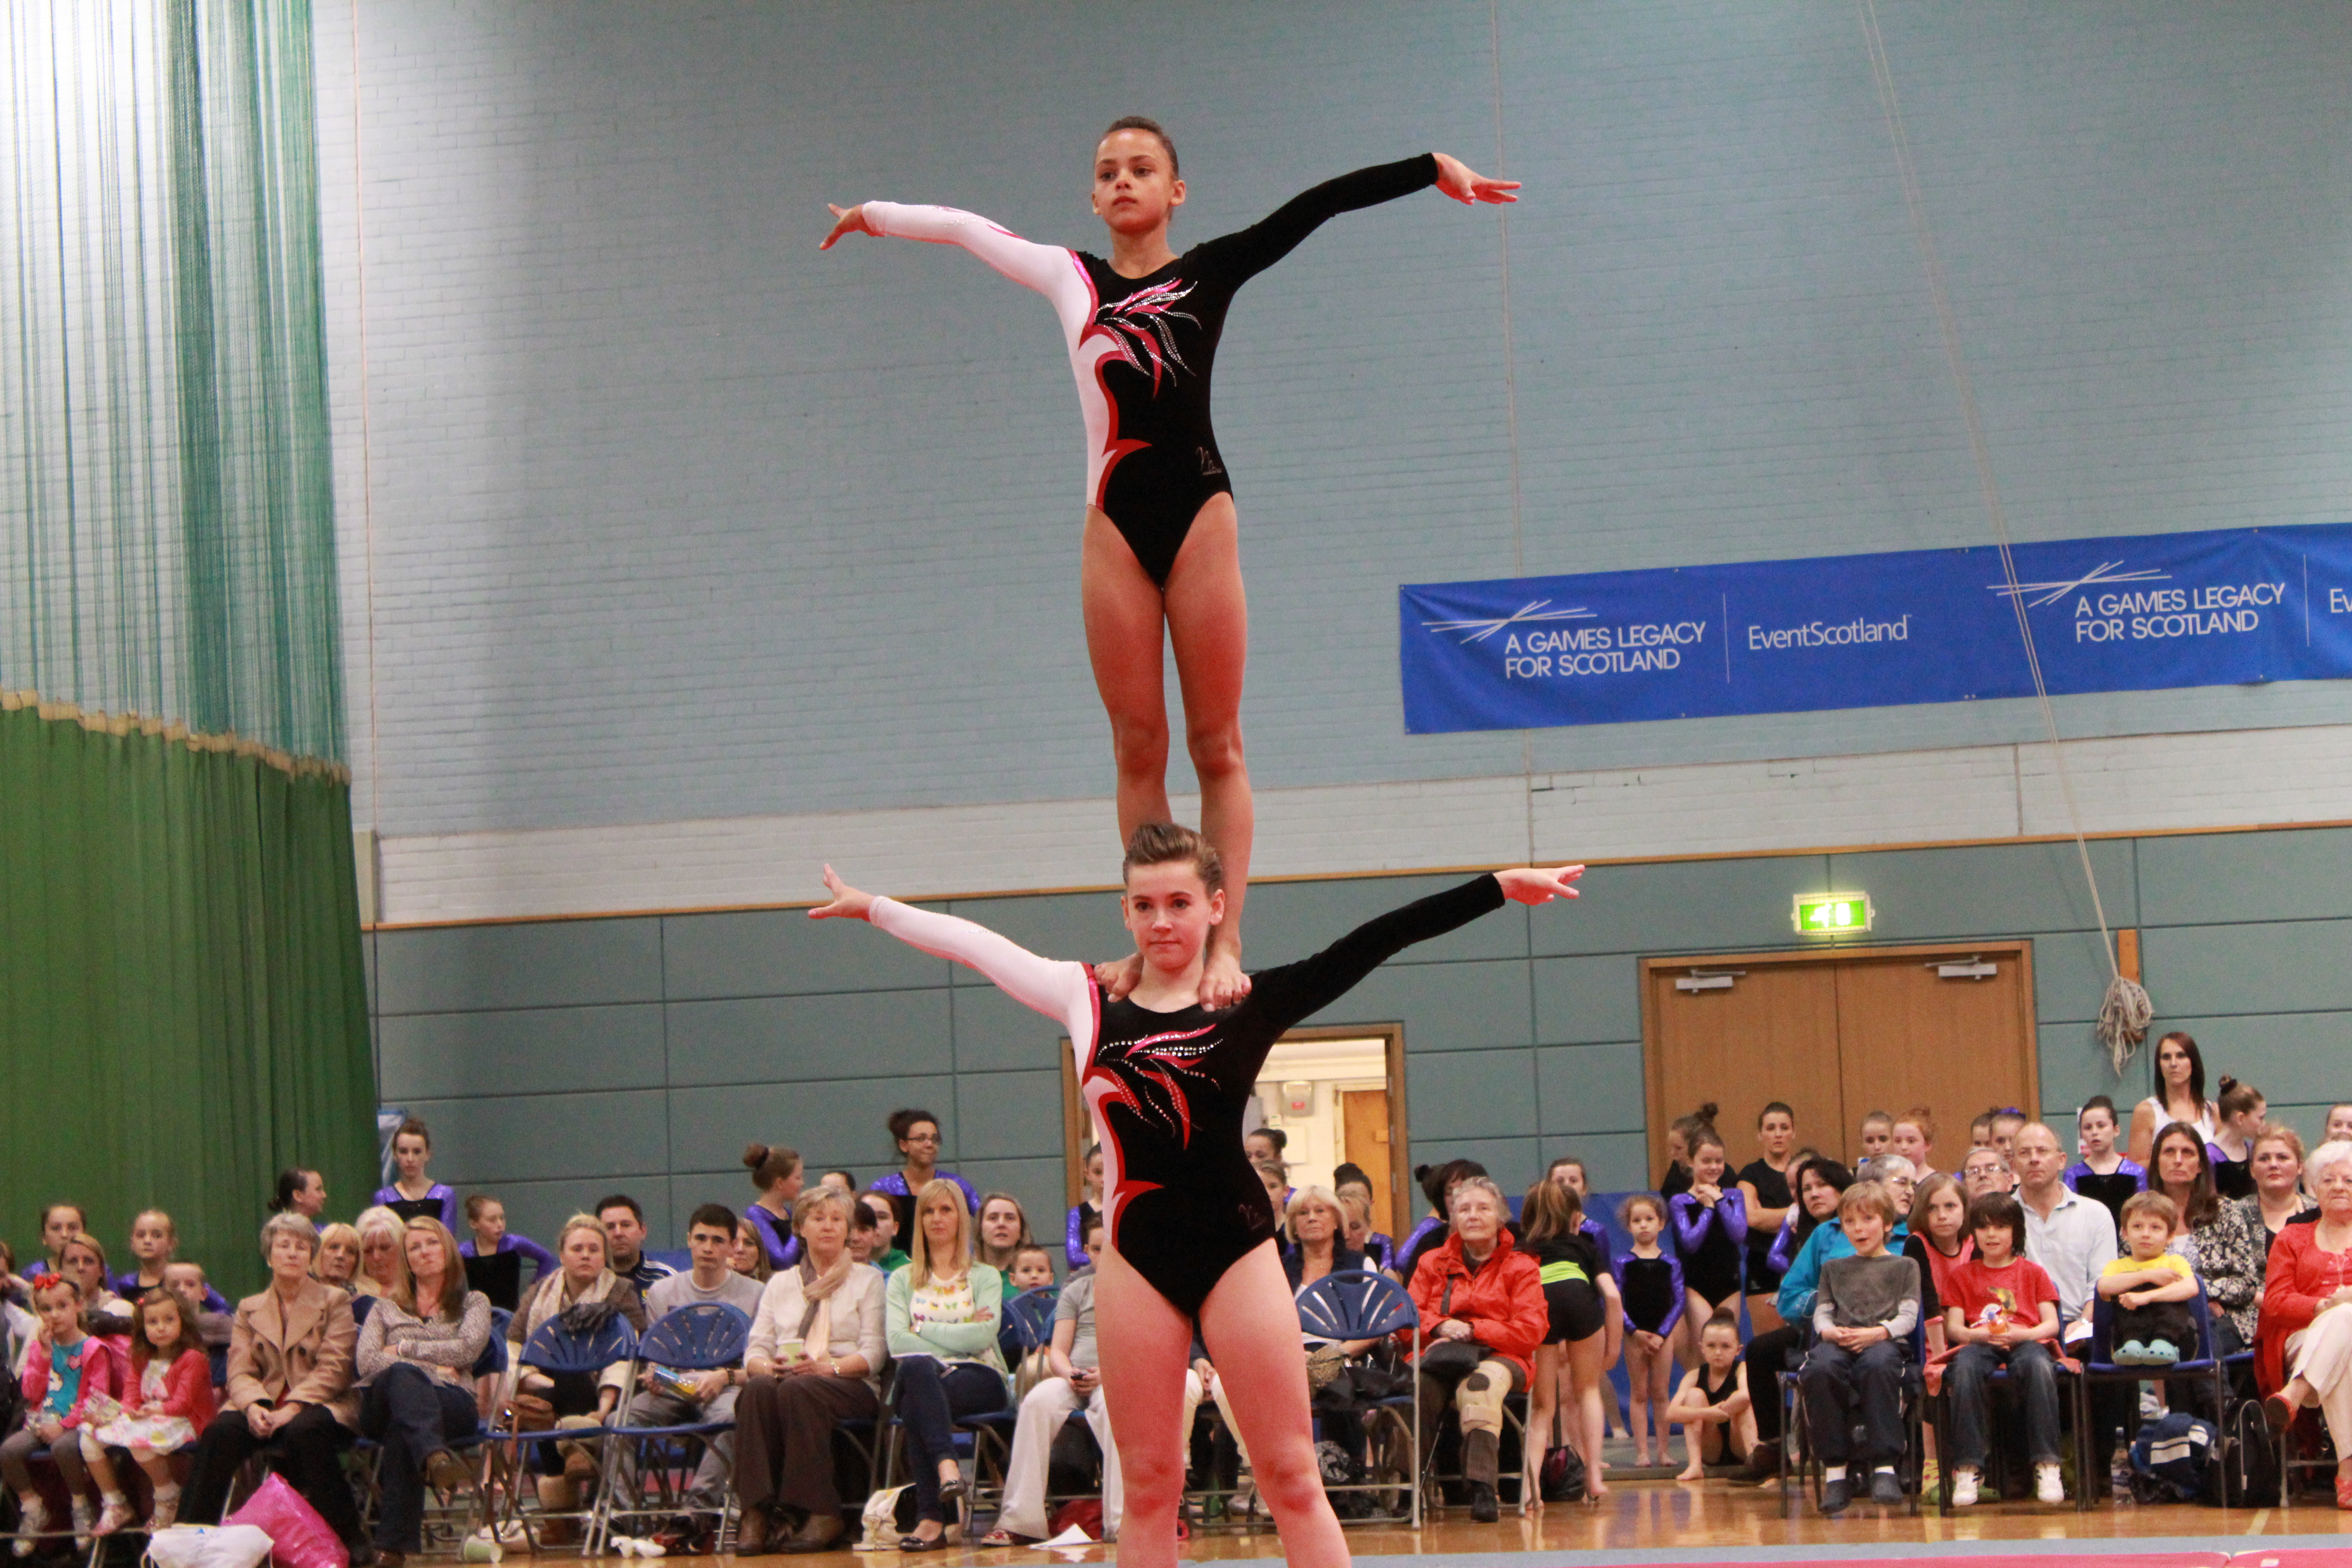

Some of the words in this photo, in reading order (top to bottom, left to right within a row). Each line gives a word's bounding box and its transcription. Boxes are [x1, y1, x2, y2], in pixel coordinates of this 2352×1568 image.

[2075, 596, 2093, 617] A
[2098, 589, 2187, 616] GAMES
[2193, 583, 2286, 609] LEGACY
[1505, 633, 1522, 654] A
[1527, 627, 1612, 653] GAMES
[1618, 621, 1706, 647] LEGACY
[1749, 615, 1908, 650] EventScotland
[2076, 618, 2125, 642] FOR
[2132, 609, 2259, 639] SCOTLAND
[1505, 657, 1552, 679] FOR
[1559, 648, 1681, 676] SCOTLAND
